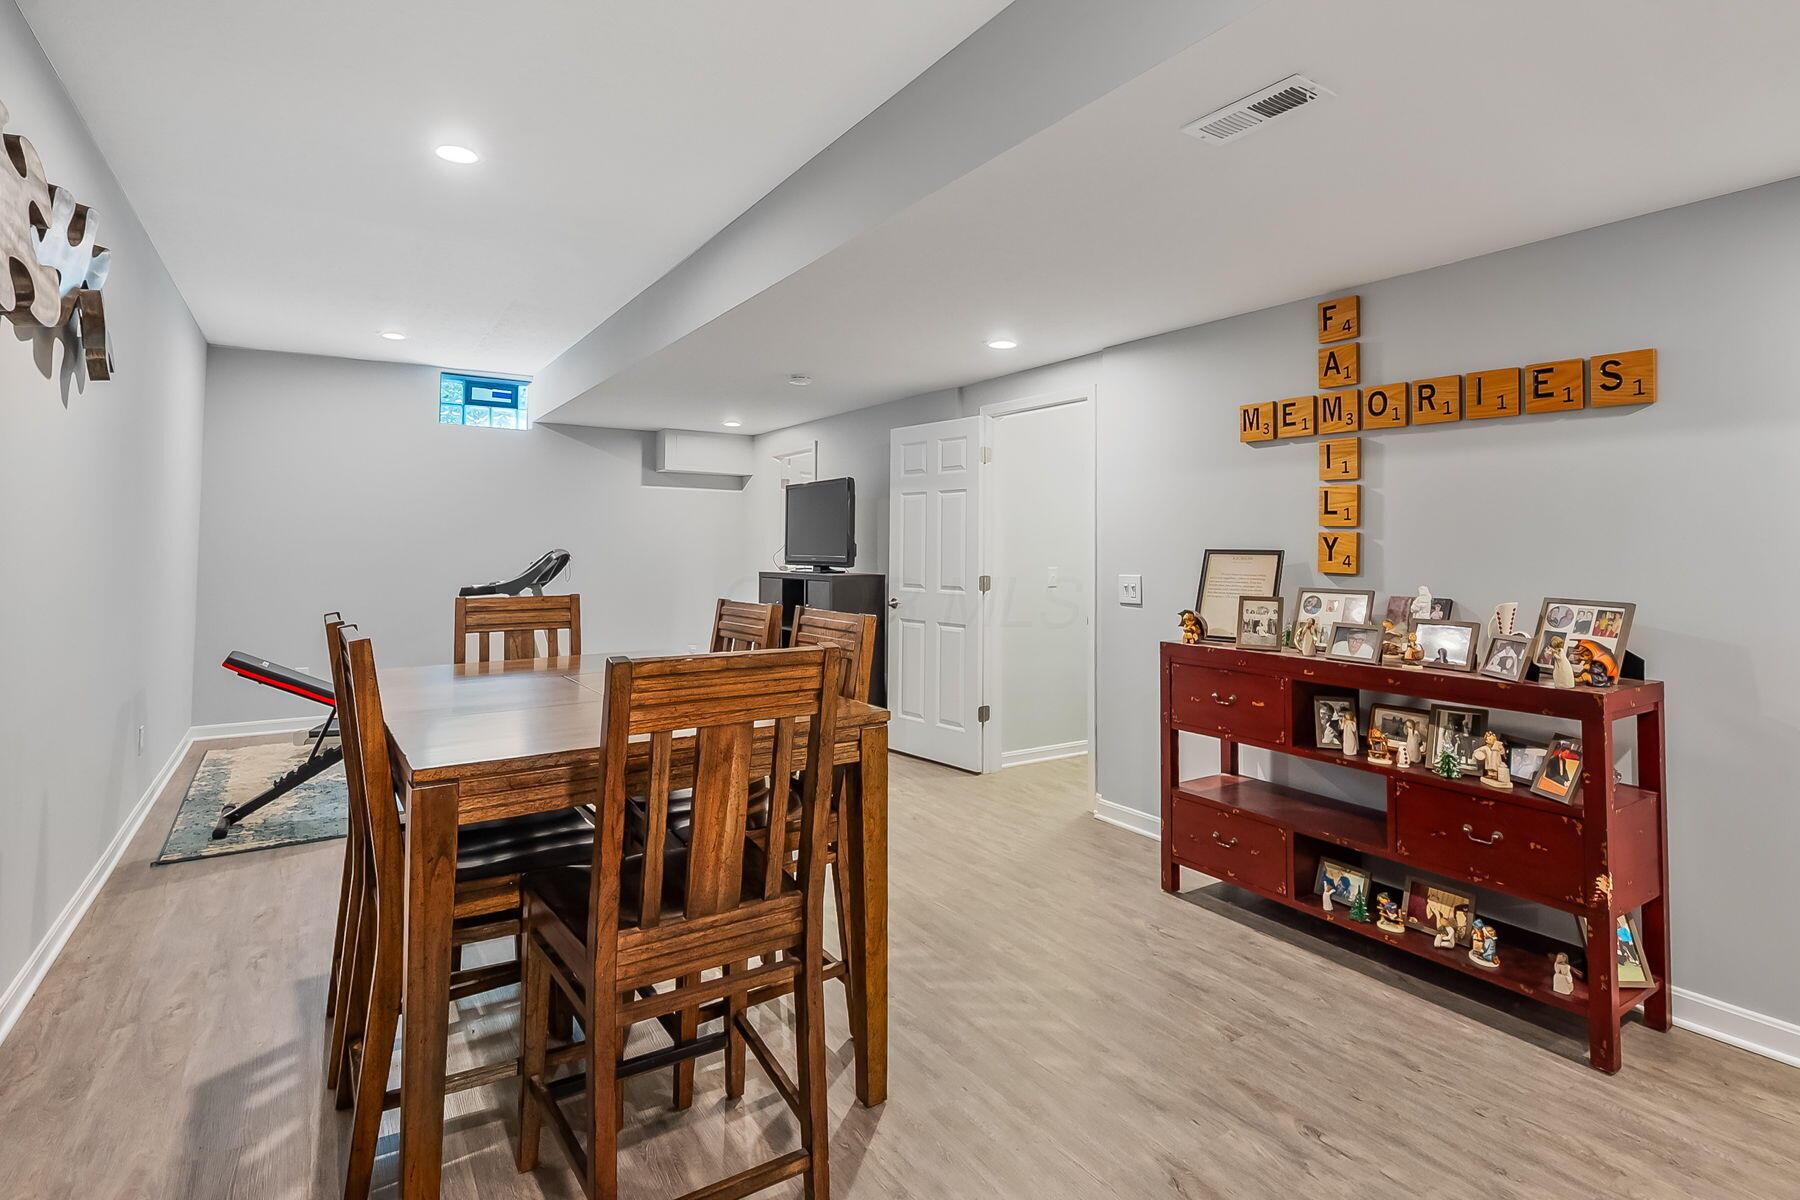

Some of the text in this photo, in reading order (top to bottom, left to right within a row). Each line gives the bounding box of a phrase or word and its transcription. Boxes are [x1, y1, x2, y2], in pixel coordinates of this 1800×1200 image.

[1342, 319, 1353, 332] 4
[1343, 366, 1352, 380] 1
[1632, 378, 1646, 396] 1
[1242, 358, 1624, 433] MEMORIES
[1562, 386, 1574, 403] 1
[1442, 400, 1453, 415] 1
[1496, 394, 1507, 410] 1
[1345, 412, 1354, 426] 3
[1391, 406, 1401, 421] 1
[1262, 422, 1271, 435] 3
[1300, 417, 1310, 431] 1
[1322, 303, 1342, 562] FAMILY
[1341, 460, 1350, 474] 1
[1343, 507, 1352, 521] 1
[1342, 554, 1352, 568] 4
